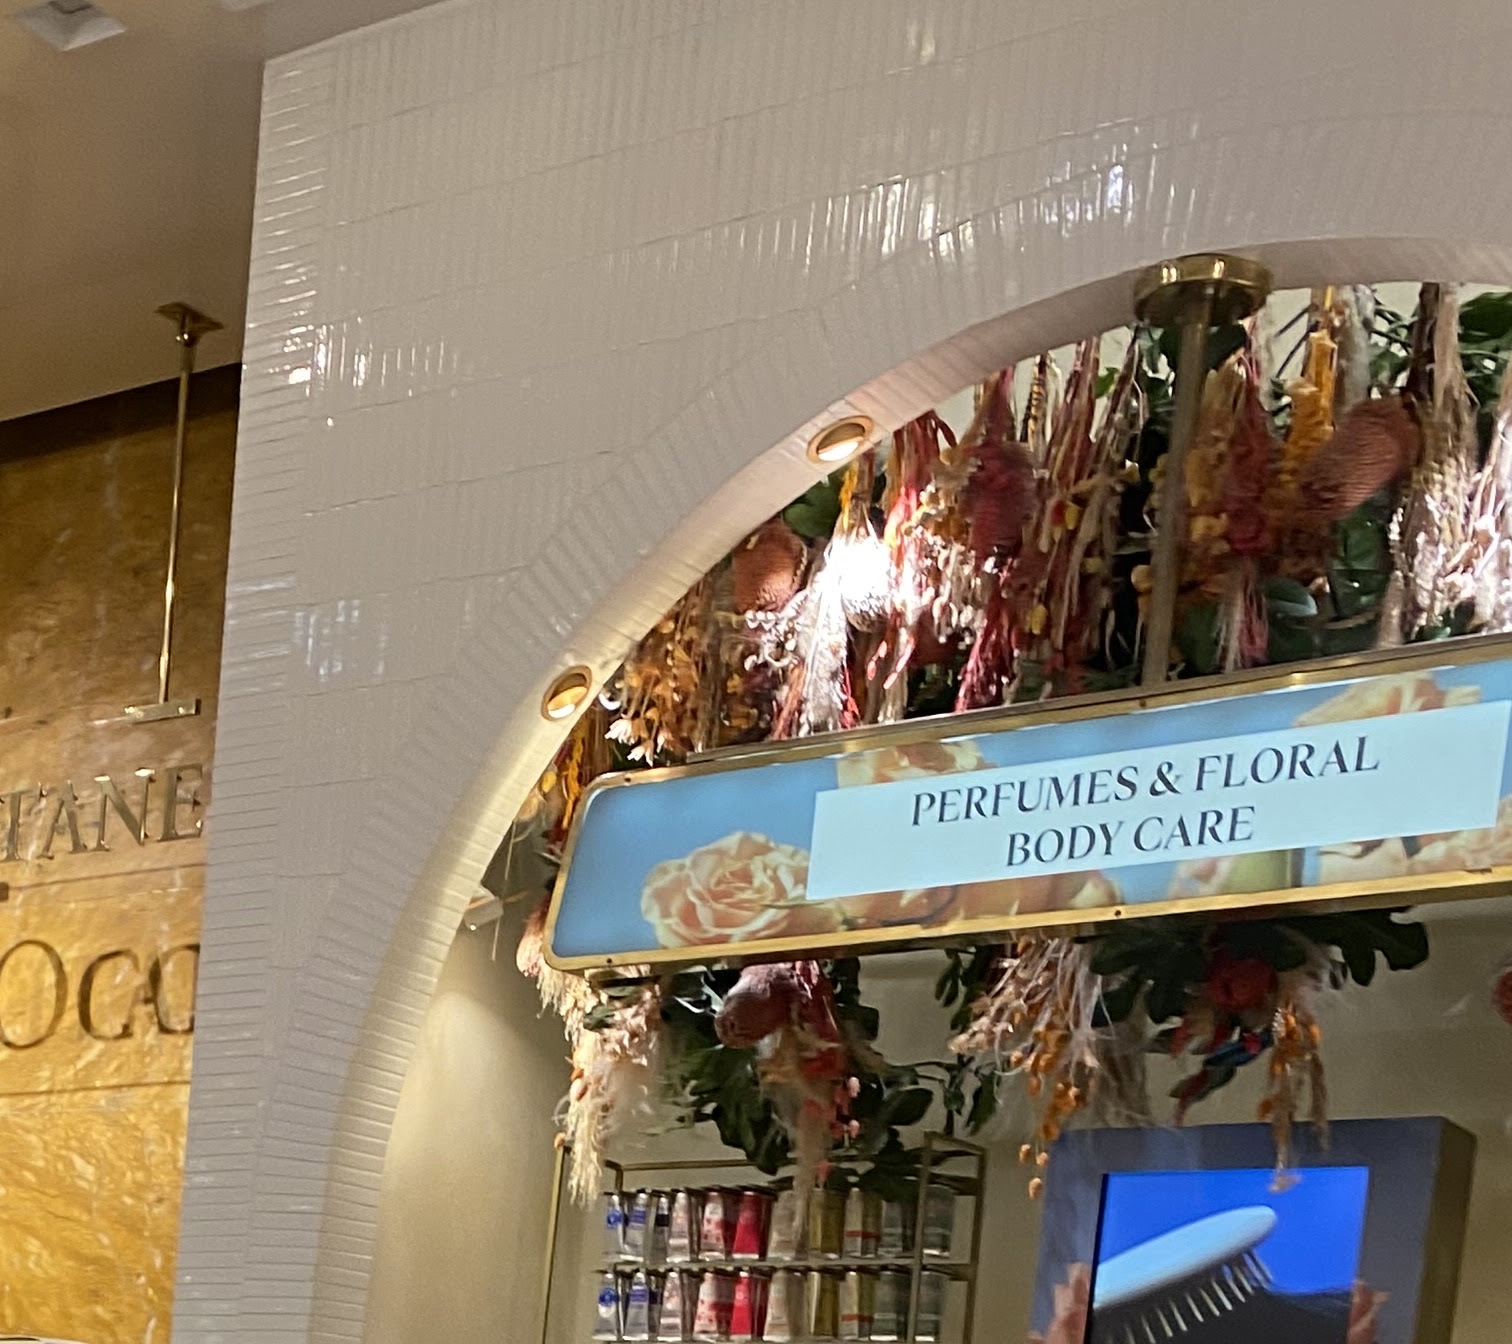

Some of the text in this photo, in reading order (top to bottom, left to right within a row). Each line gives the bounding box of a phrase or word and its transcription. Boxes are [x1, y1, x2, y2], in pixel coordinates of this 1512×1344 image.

[912, 735, 1381, 827] PERFUMES & FLORAL
[1006, 805, 1256, 868] BODY CARE
